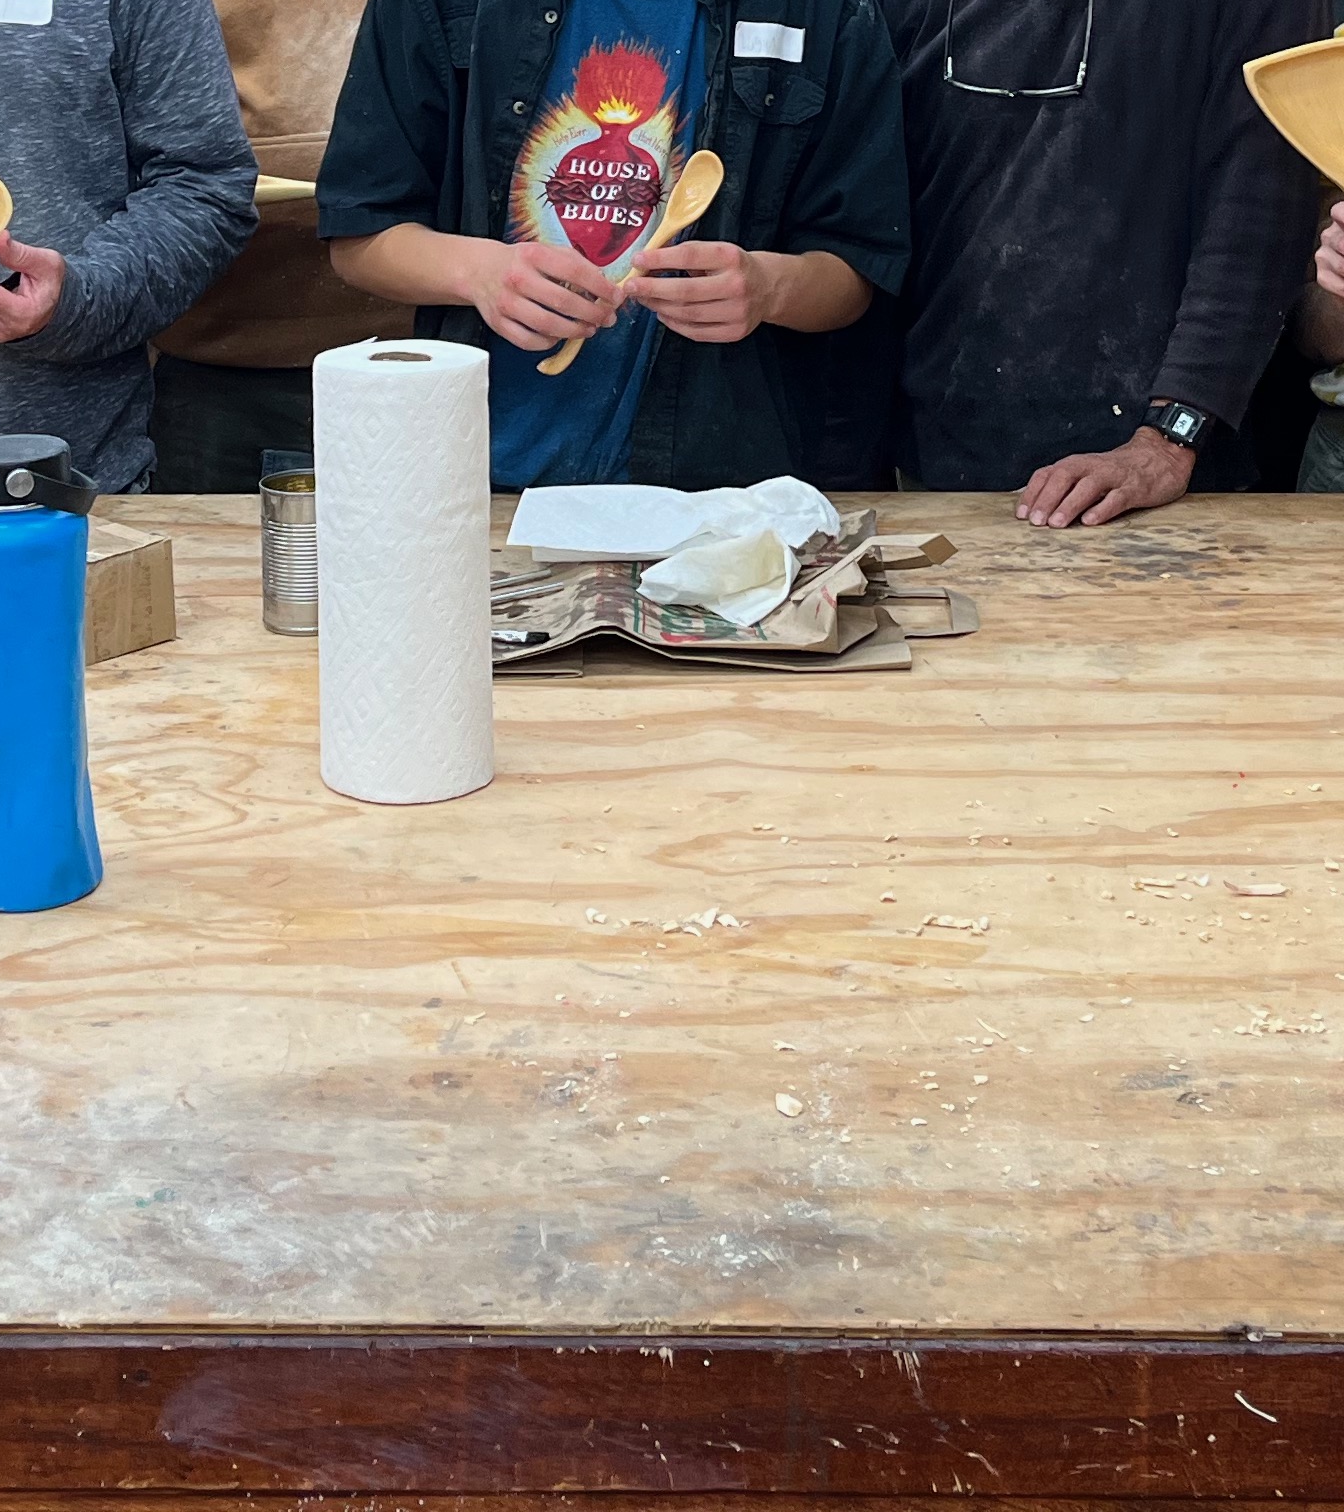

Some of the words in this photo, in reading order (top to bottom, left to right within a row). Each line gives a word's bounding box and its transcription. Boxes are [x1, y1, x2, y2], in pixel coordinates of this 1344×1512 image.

[568, 158, 652, 181] HOUSE
[591, 183, 622, 200] OF
[561, 204, 644, 227] BLUES
